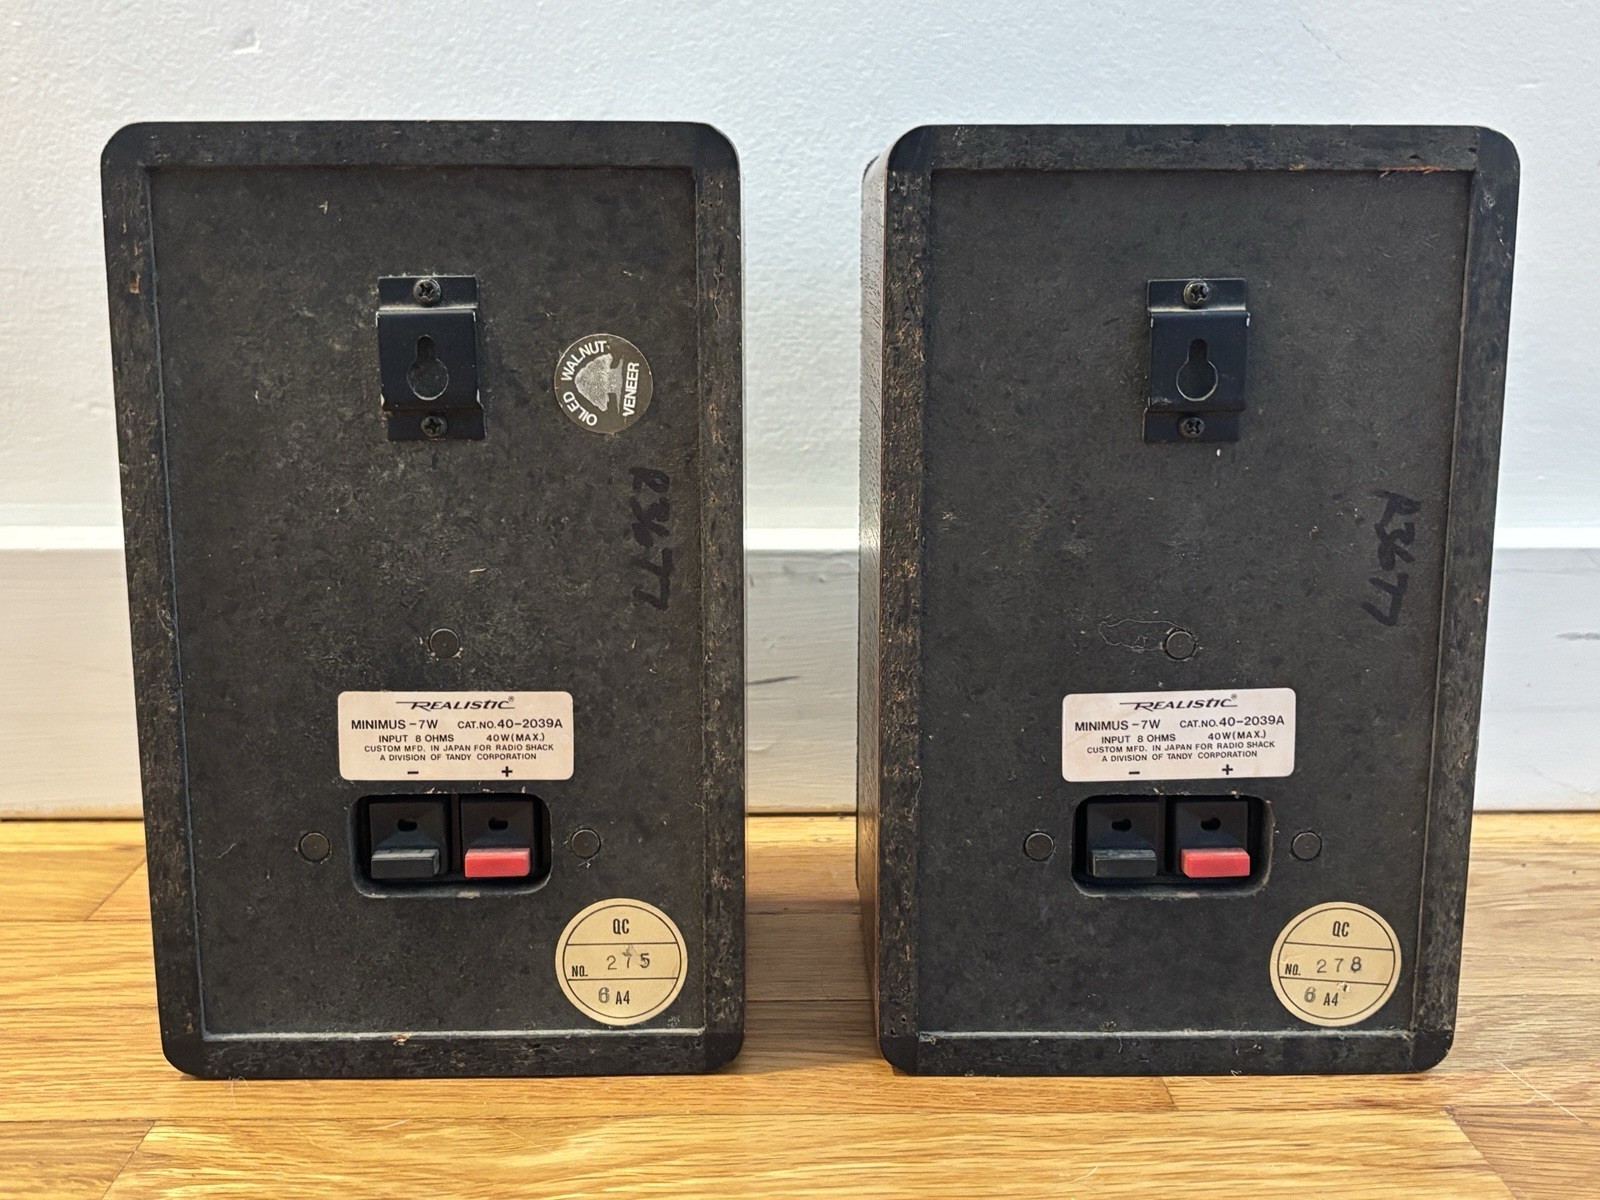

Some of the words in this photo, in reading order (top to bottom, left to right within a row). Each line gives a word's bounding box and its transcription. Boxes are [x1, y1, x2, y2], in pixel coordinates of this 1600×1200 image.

[561, 340, 607, 381] WALNUT
[622, 362, 640, 417] VENEER
[563, 391, 598, 426] OILED
[378, 734, 409, 743] INPUT
[415, 734, 422, 743] 8
[424, 734, 454, 743] OHMS
[1101, 735, 1131, 744] INPUT
[1137, 734, 1144, 743] 8
[1146, 733, 1176, 743] OHMS
[364, 744, 401, 752] CUSTOM
[404, 744, 426, 752] MFD.
[430, 744, 439, 752] IN
[443, 744, 471, 752] JAPAN
[474, 744, 492, 752] FOR
[525, 743, 554, 751] SHACK
[1086, 746, 1123, 754] CUSTOM
[1126, 745, 1148, 753] MFD.
[1152, 744, 1161, 752] IN
[1164, 743, 1193, 752] JAPAN
[1195, 742, 1213, 750] FOR
[1216, 741, 1244, 750] RADIO
[1247, 740, 1275, 749] SHACK
[379, 753, 386, 761] A
[389, 753, 426, 761] DIVISION
[430, 753, 442, 761] OF
[446, 753, 471, 761] TANDY
[476, 752, 537, 760] CORPORATION
[1101, 755, 1108, 763] A
[1110, 753, 1147, 762] DIVISION
[1152, 753, 1163, 761] OF
[1167, 752, 1193, 760] TANDY
[1197, 750, 1258, 759] CORPORATION
[612, 918, 630, 935] QC
[1331, 920, 1350, 938] QC
[571, 965, 589, 978] NO.
[1284, 963, 1302, 976] NO.
[1316, 956, 1362, 974] 278
